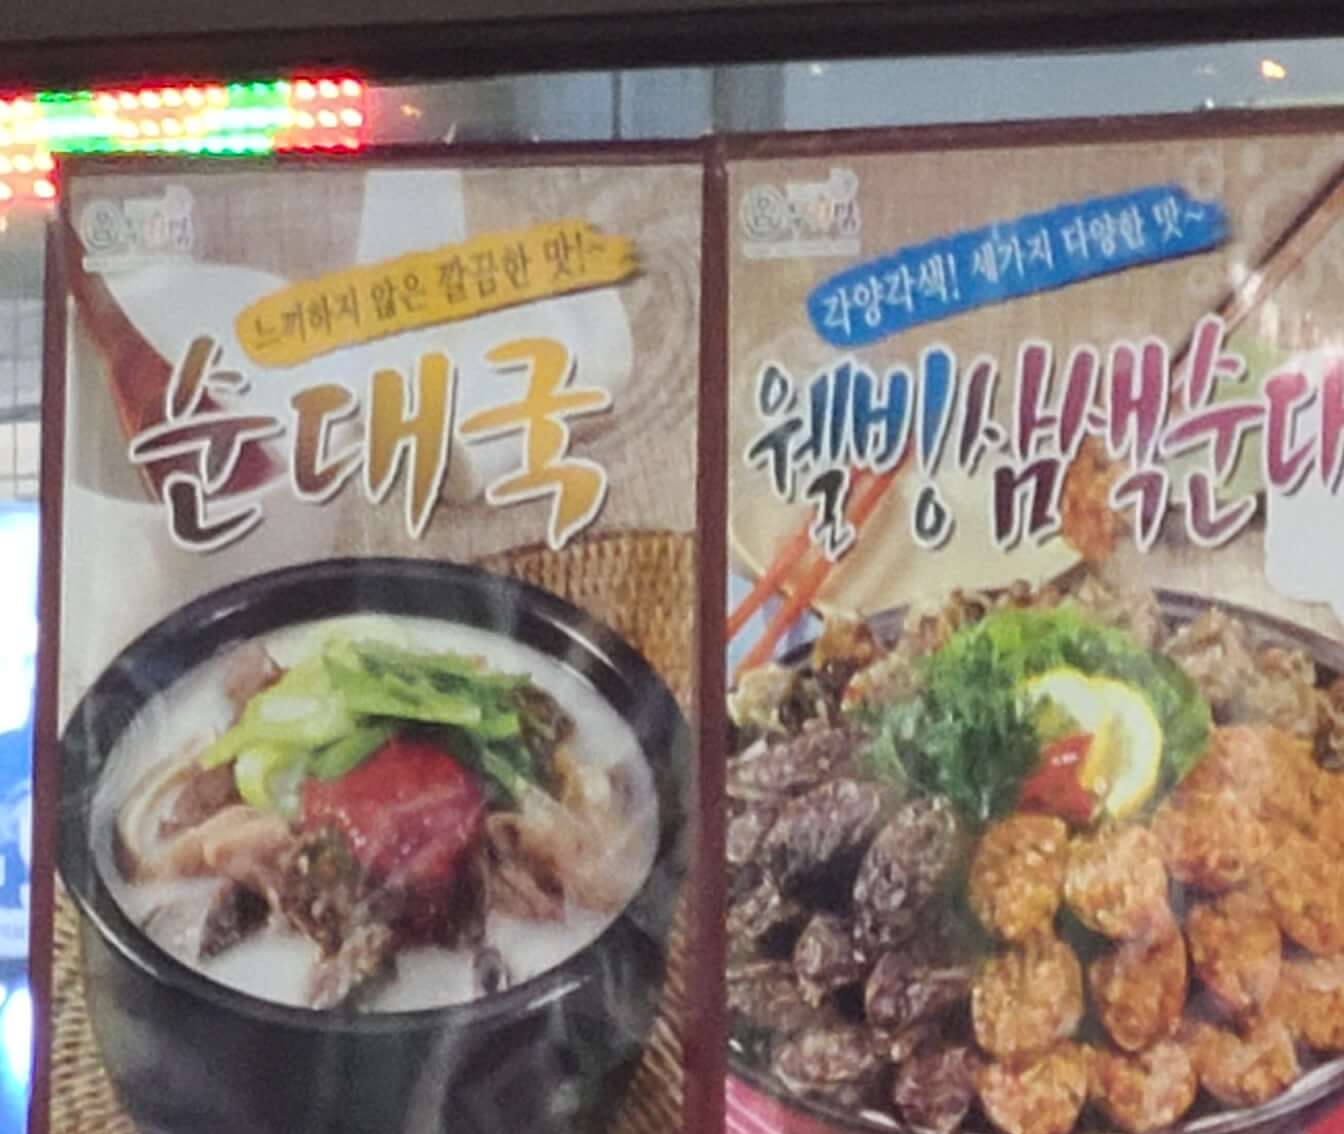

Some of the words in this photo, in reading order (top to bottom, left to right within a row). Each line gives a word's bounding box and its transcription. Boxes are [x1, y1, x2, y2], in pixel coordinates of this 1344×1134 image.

[253, 289, 359, 350] 느끼하지
[369, 273, 426, 321] 않은
[437, 244, 531, 306] 깔끔한
[971, 227, 1054, 283] 세가지
[130, 335, 613, 551] 순대국
